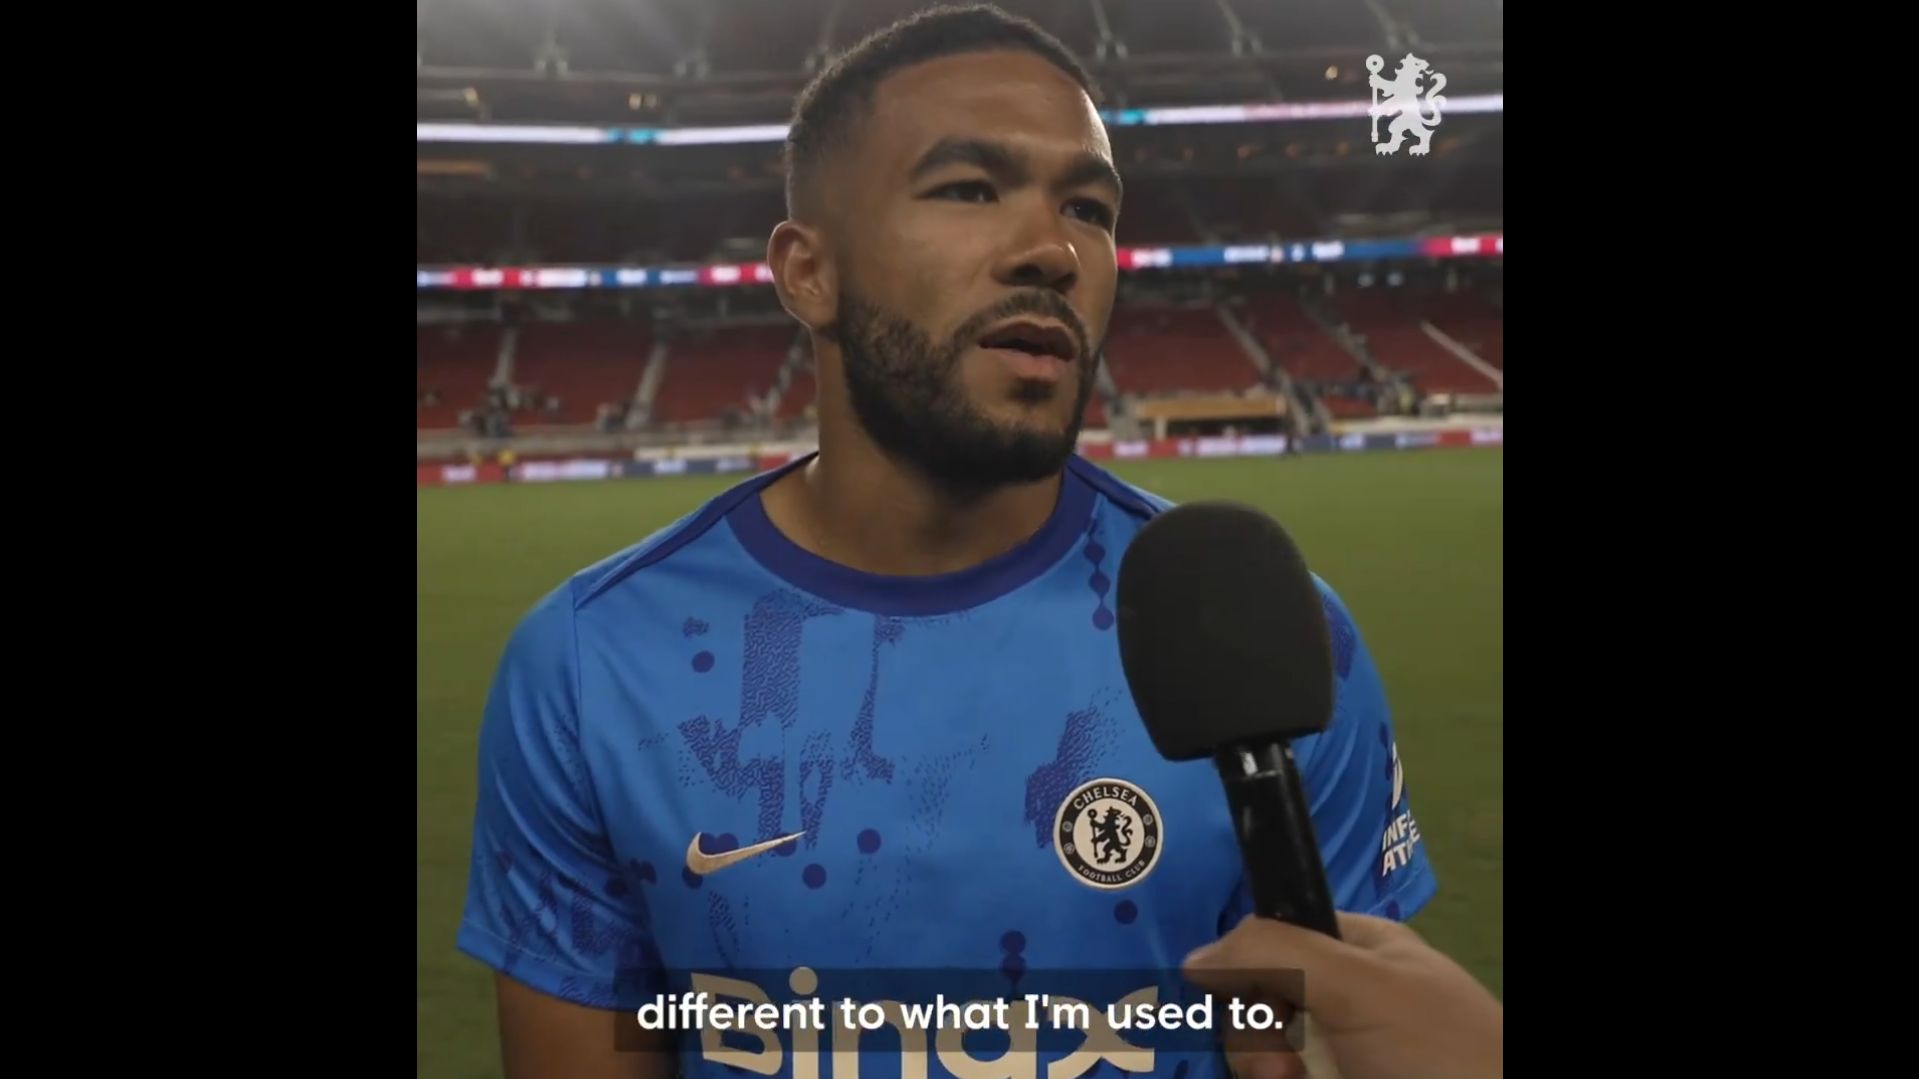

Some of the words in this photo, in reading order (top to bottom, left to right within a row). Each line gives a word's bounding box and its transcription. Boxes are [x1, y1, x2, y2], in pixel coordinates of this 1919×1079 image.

[1073, 786, 1138, 810] CHELSEA
[1078, 864, 1123, 883] FOOTBALL
[1125, 859, 1146, 878] CLUB
